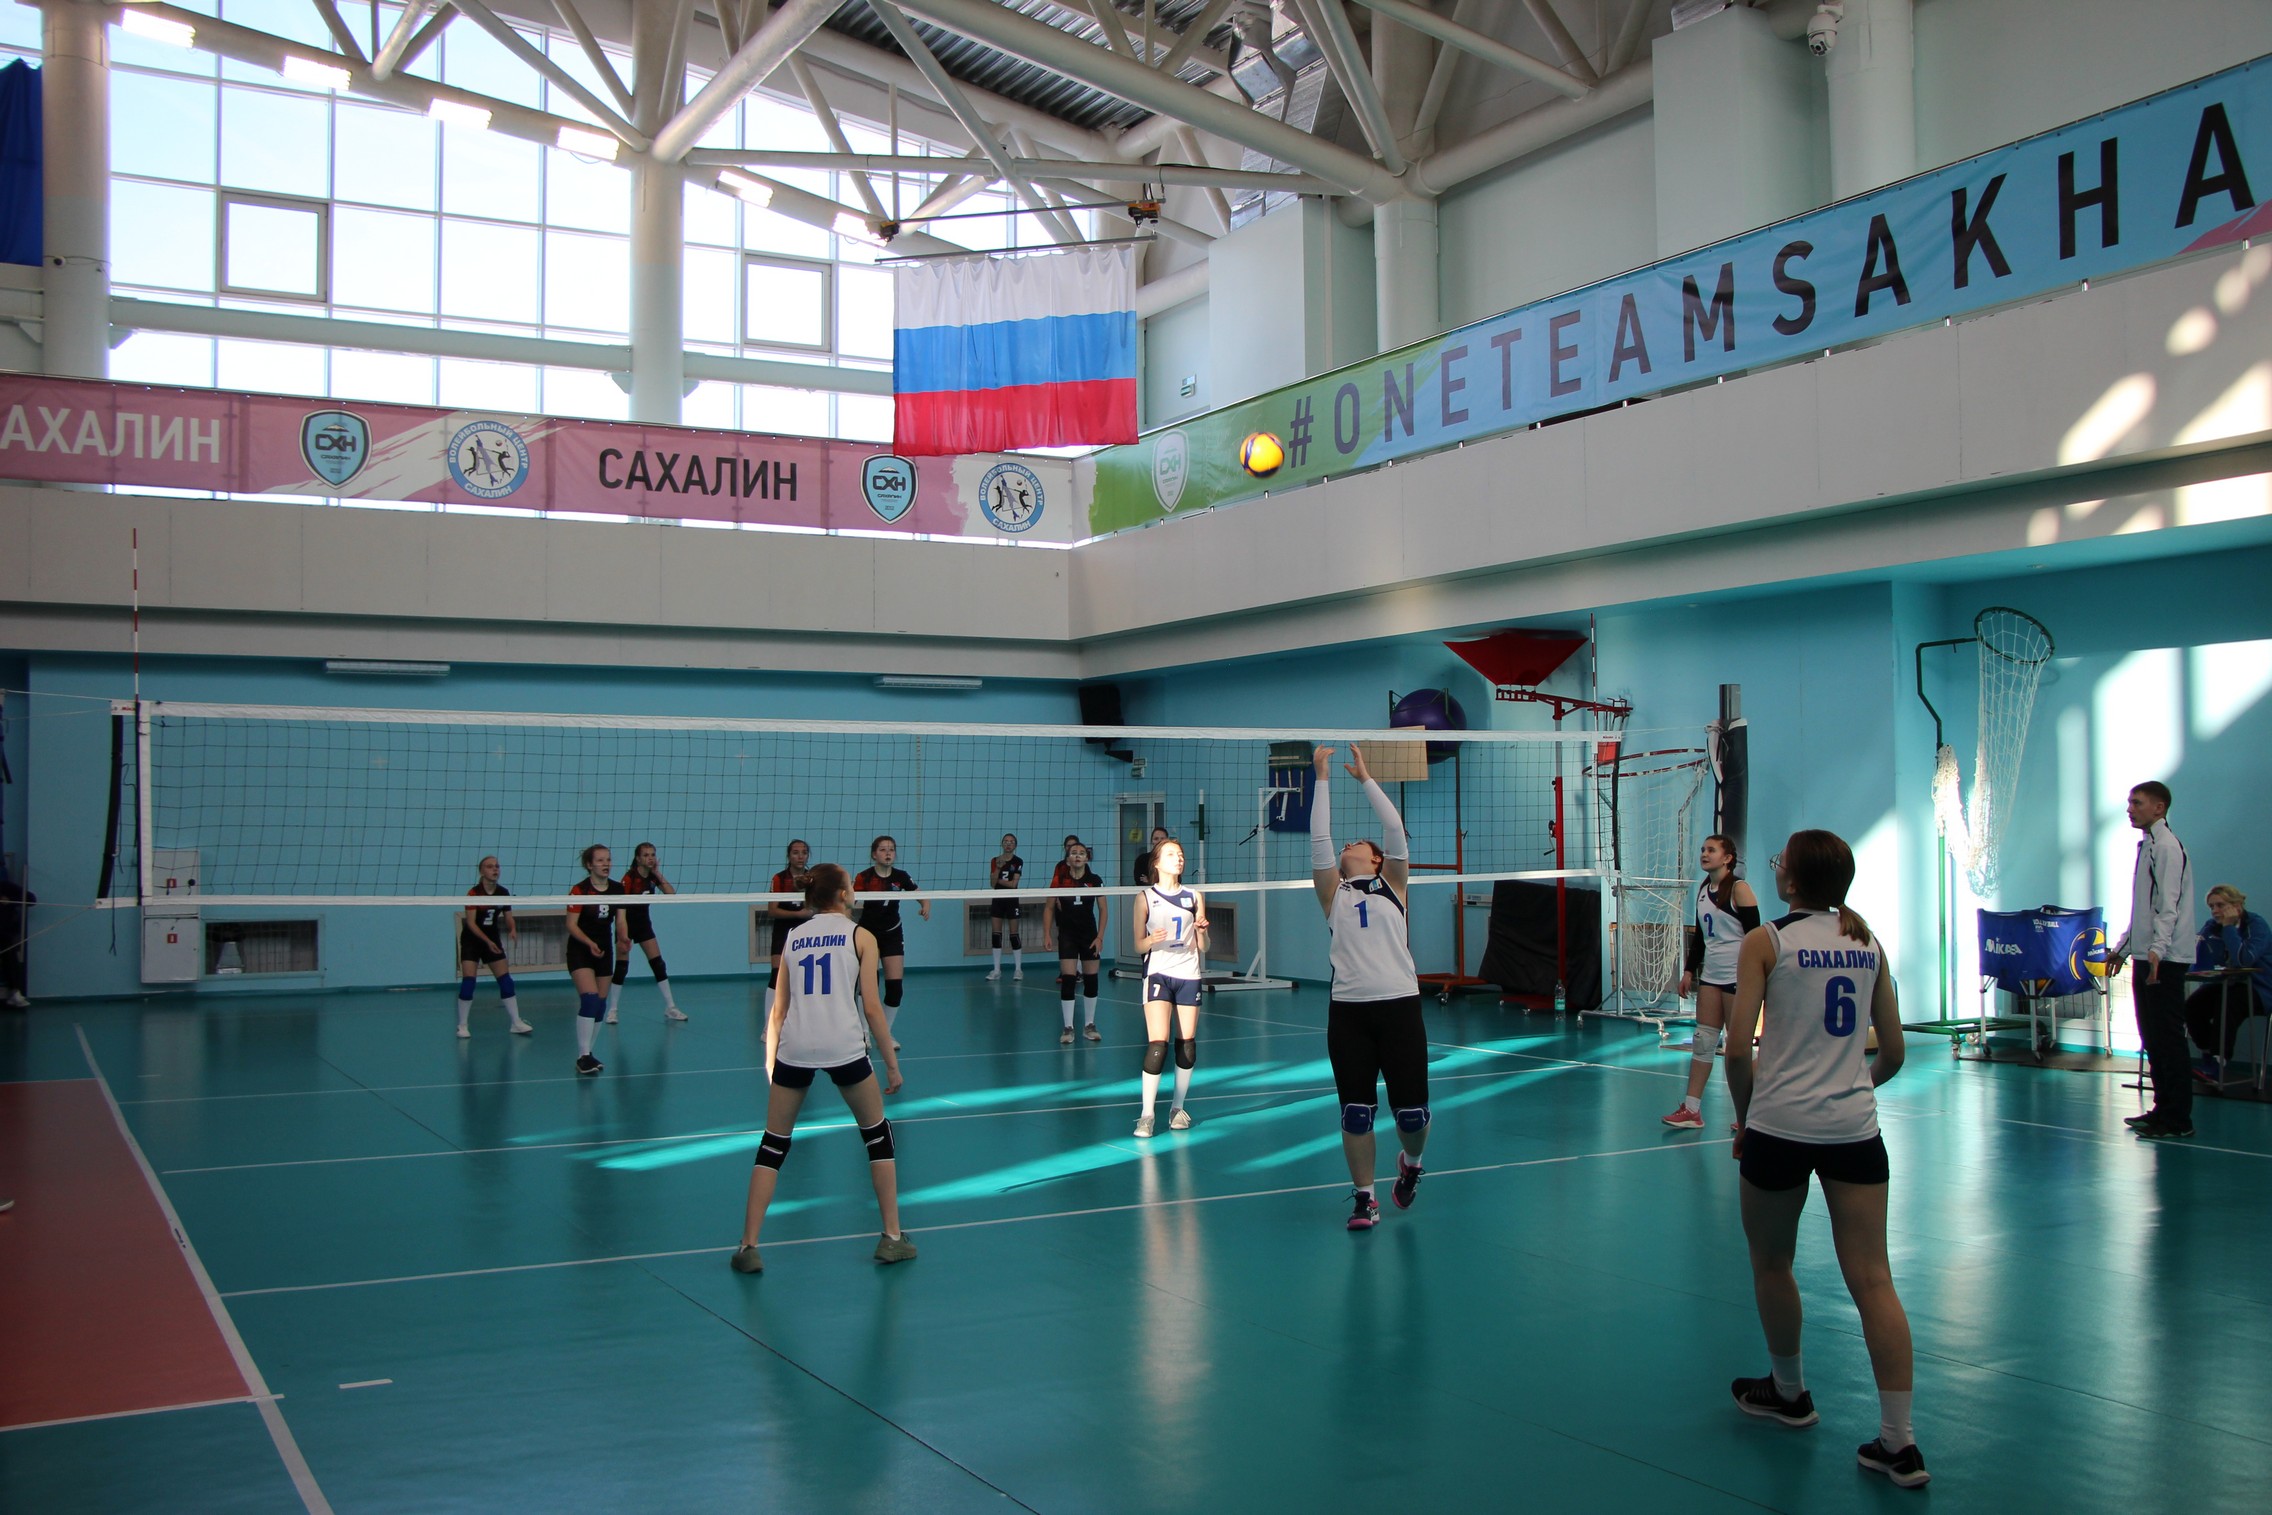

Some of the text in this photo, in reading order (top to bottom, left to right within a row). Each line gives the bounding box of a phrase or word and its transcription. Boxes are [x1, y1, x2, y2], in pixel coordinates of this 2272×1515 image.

[1287, 101, 2256, 469] #ONETEAMSAKHA
[599, 448, 797, 501] САХАЛИН
[464, 483, 512, 497] САХАЛИН
[992, 518, 1031, 531] САХАЛИН
[1354, 900, 1368, 928] 1
[1703, 913, 1715, 937] 2
[1171, 917, 1183, 940] 7
[791, 934, 847, 951] САХАЛИН
[1797, 948, 1876, 971] САХАЛИН
[798, 952, 832, 995] 11
[1152, 984, 1161, 997] 7
[1824, 975, 1857, 1038] 6
